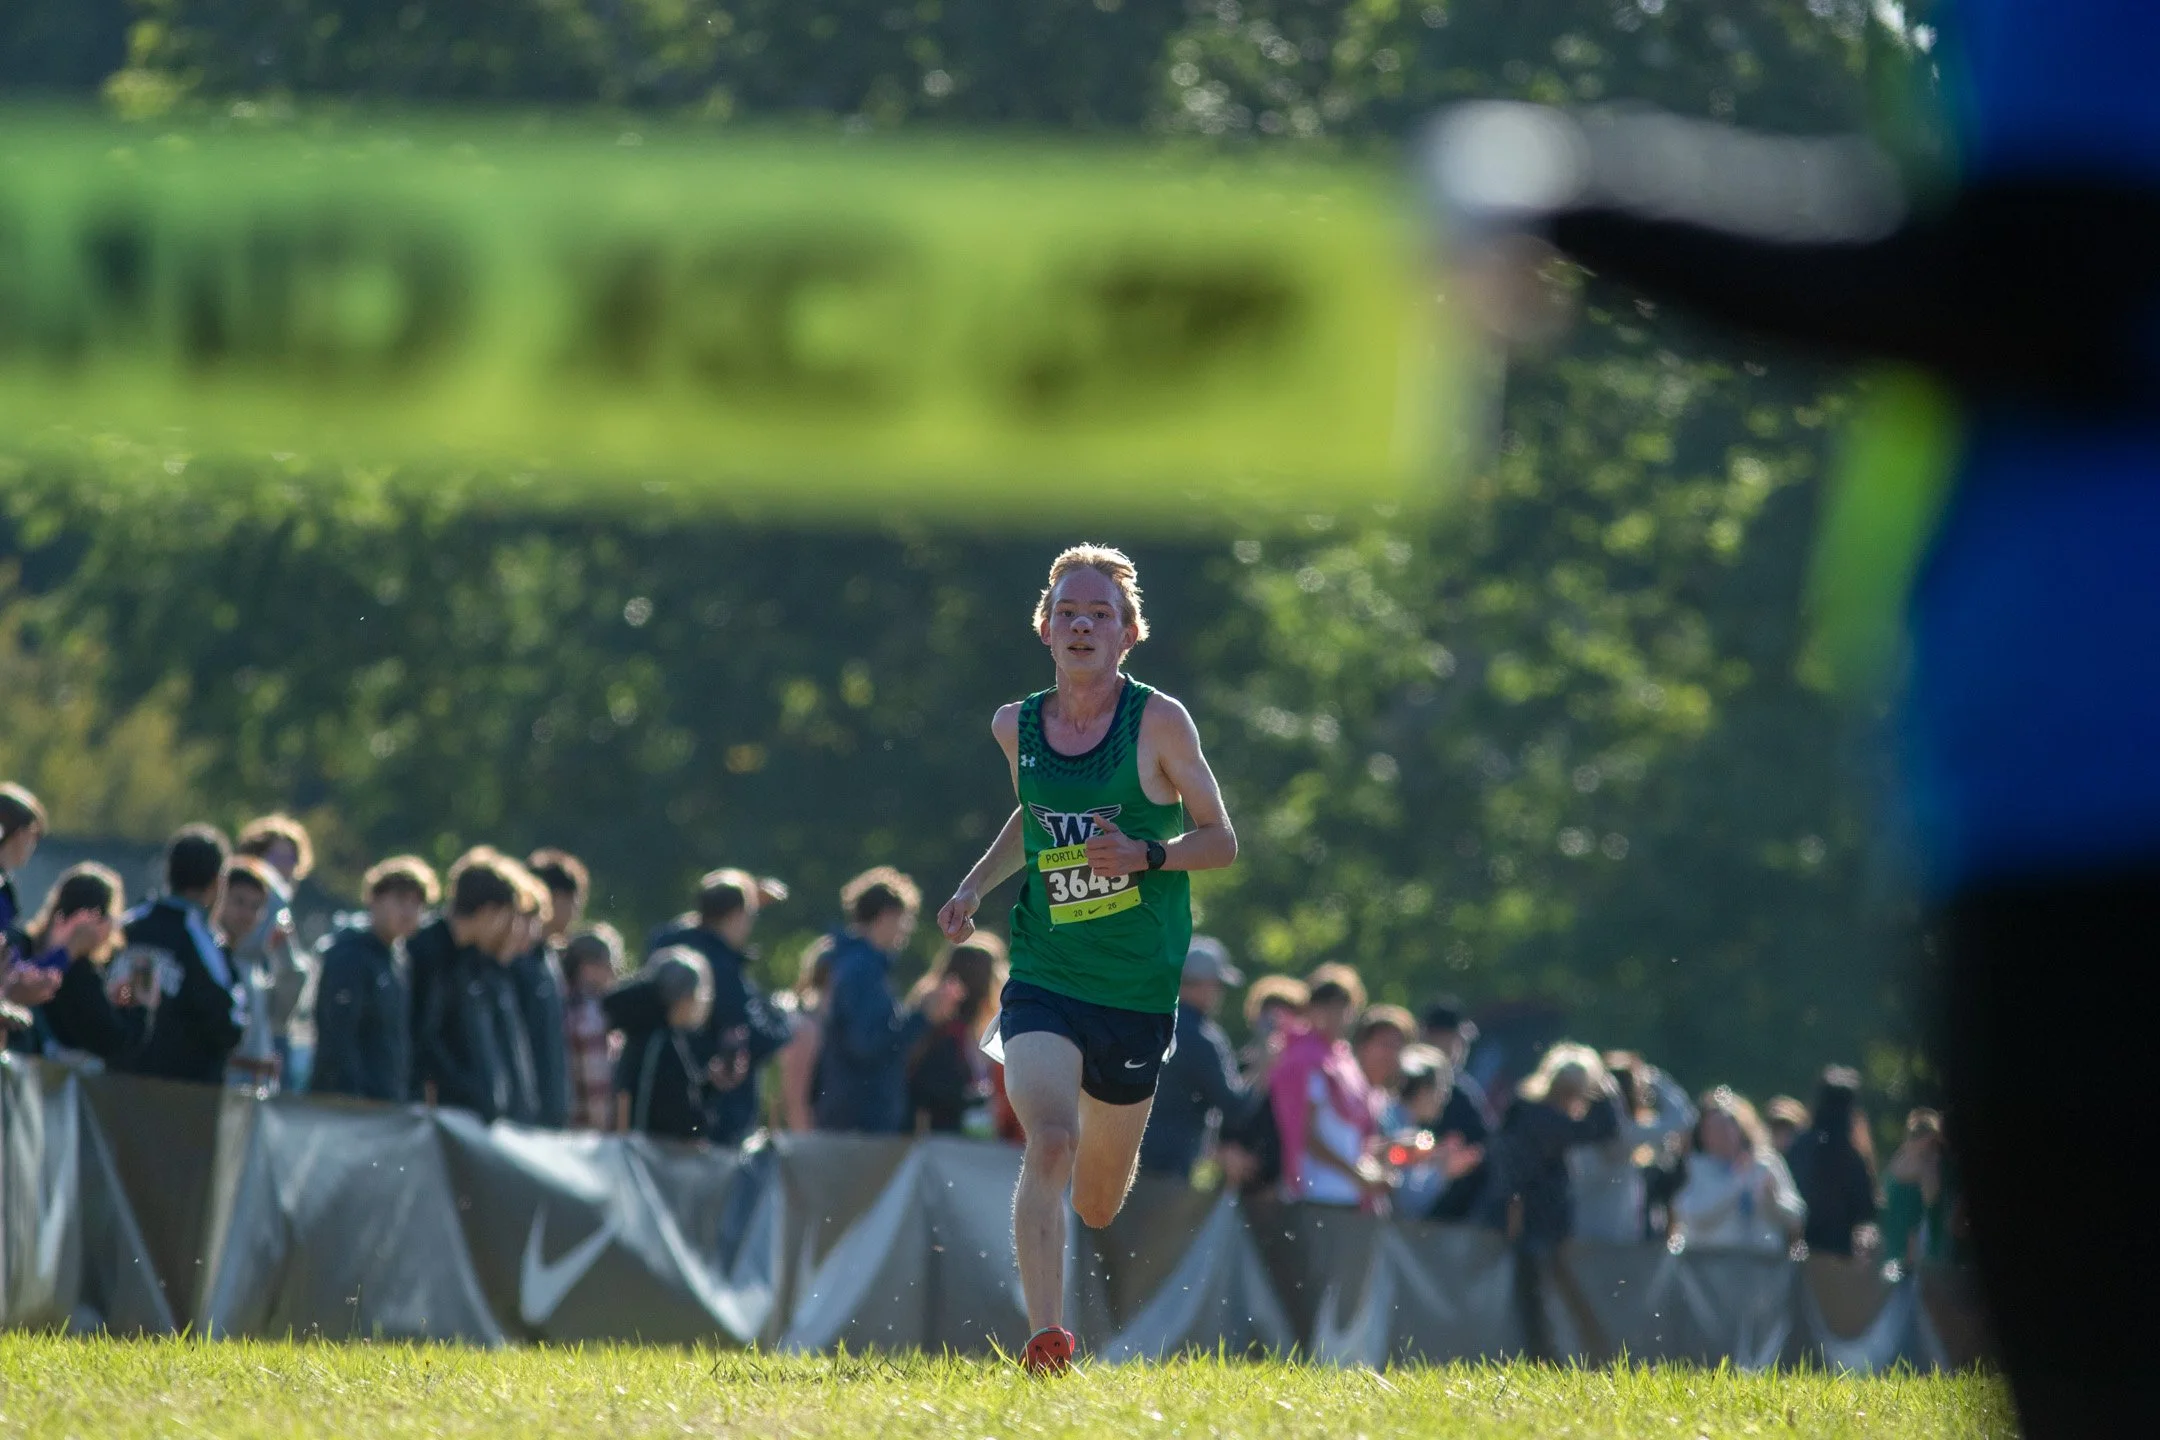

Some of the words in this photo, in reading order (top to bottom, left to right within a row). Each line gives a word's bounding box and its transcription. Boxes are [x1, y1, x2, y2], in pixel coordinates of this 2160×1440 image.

[1045, 812, 1095, 847] W
[1045, 849, 1088, 863] PORTLA
[1073, 909, 1083, 918] 20
